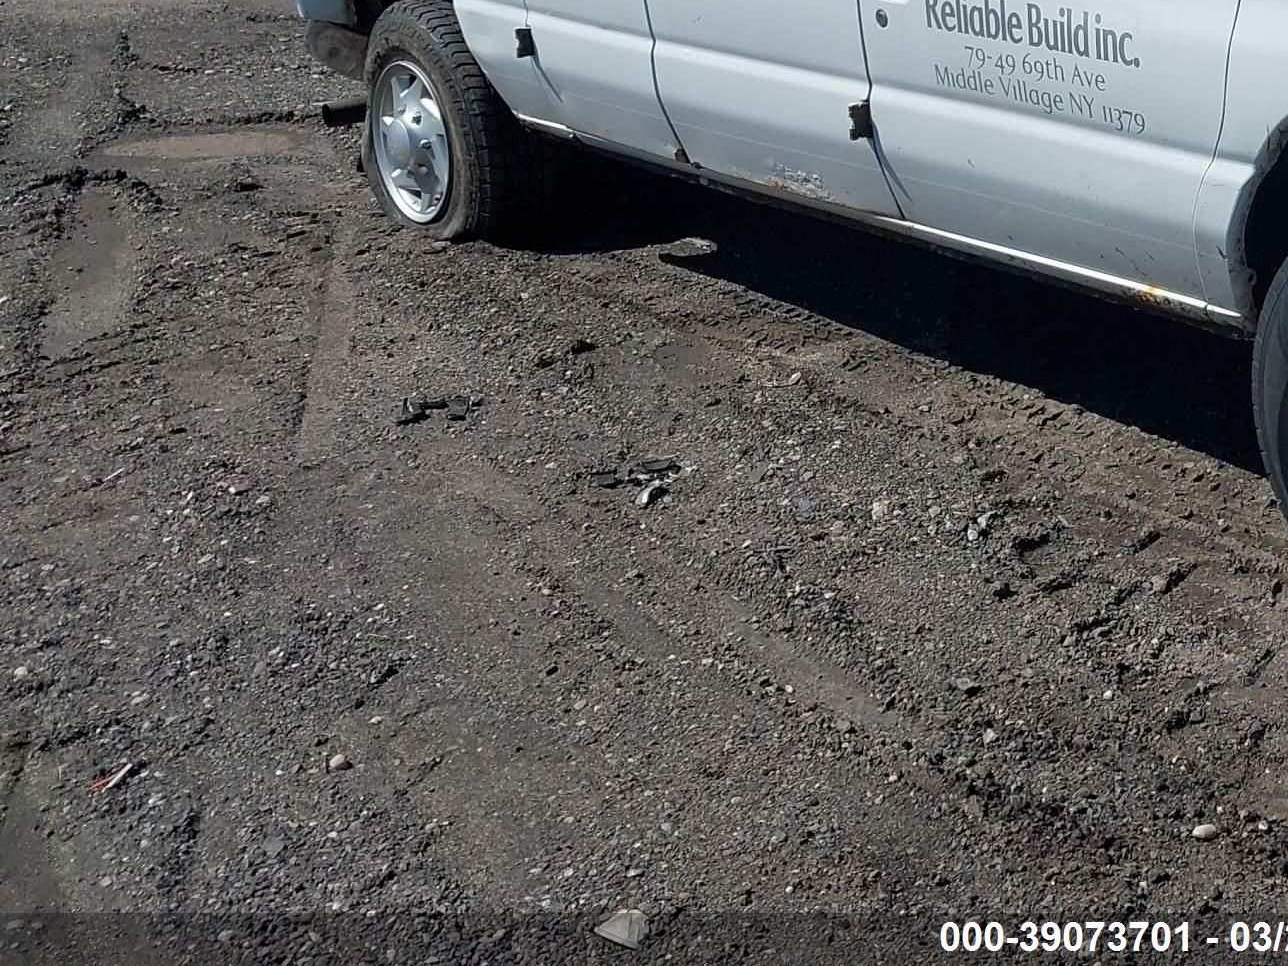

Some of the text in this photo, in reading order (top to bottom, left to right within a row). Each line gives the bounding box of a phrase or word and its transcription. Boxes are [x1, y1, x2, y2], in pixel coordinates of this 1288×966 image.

[1027, 2, 1090, 57] Build
[1094, 13, 1141, 68] inc.
[934, 64, 1145, 135] Middle Village NY 11379
[964, 46, 1106, 92] 79-49 69th Ave
